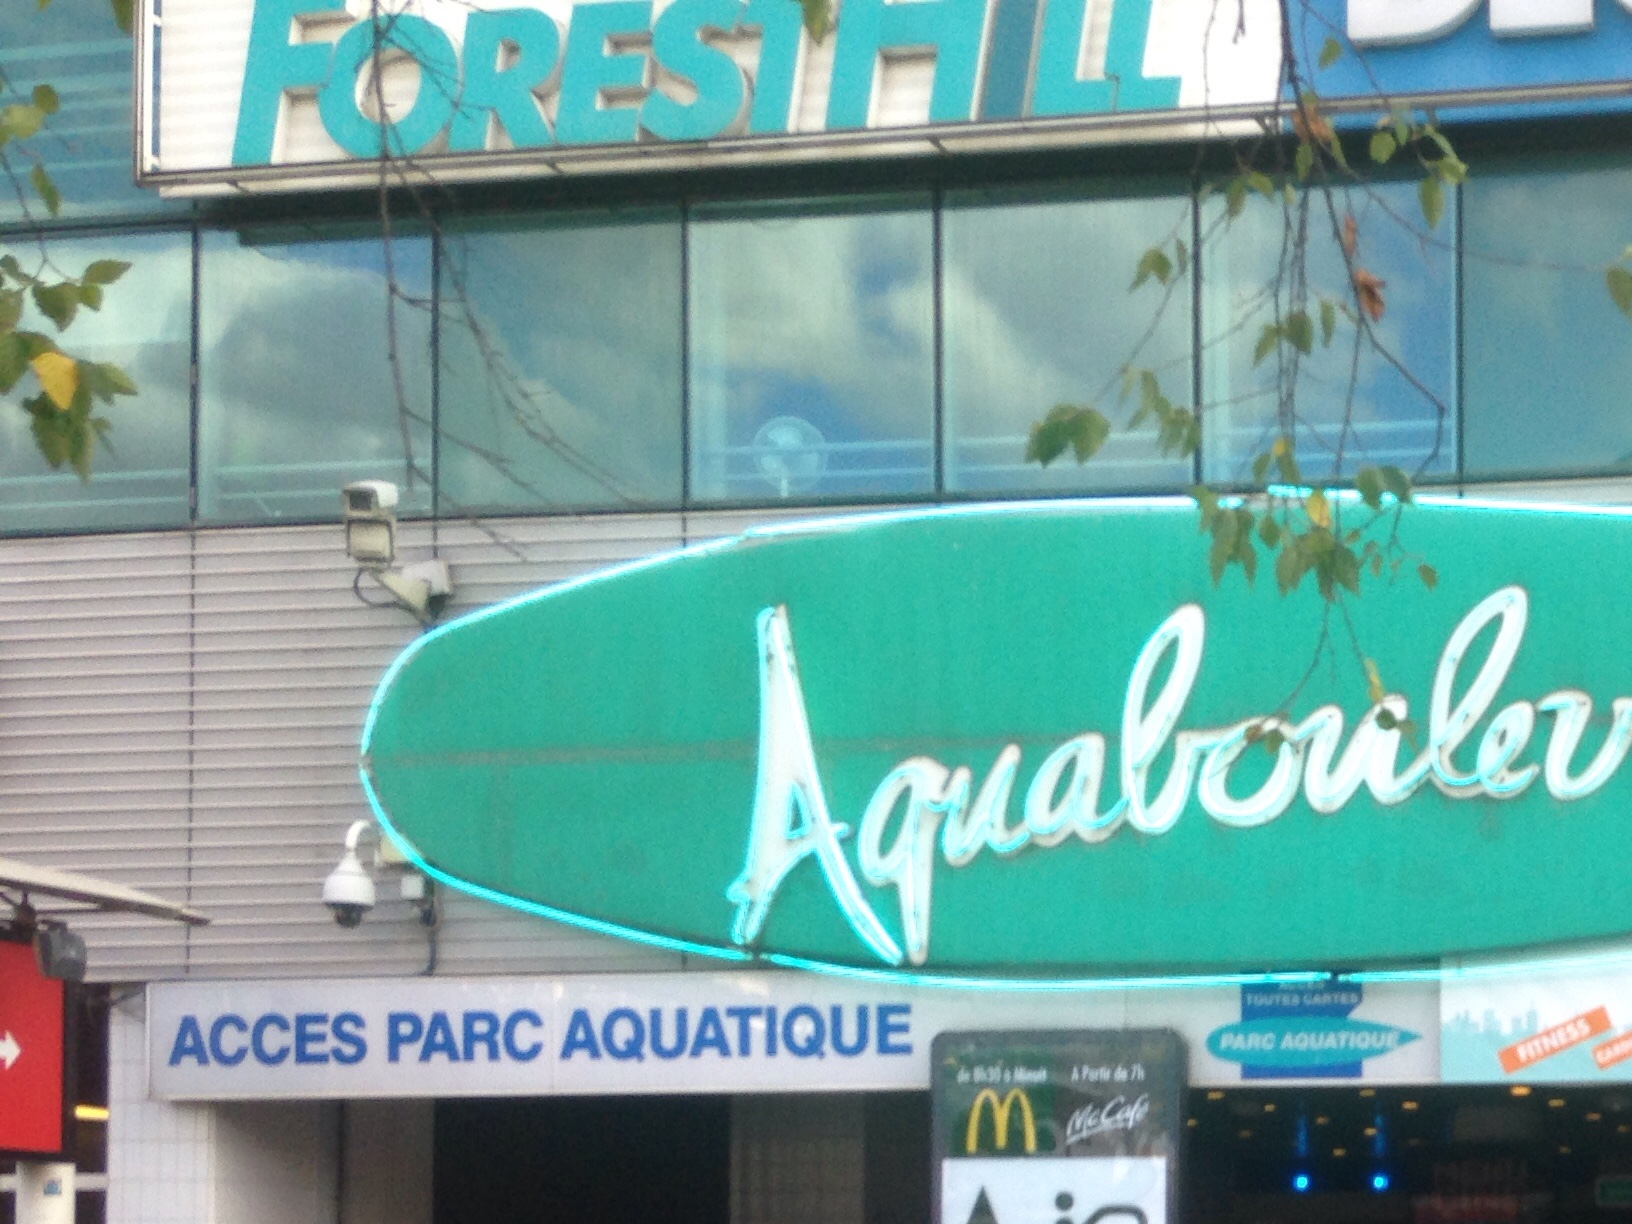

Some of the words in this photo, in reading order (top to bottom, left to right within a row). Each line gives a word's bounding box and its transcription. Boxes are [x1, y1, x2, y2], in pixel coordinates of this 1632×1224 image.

[168, 1012, 369, 1067] ACCES
[387, 1008, 545, 1064] PARC
[561, 1004, 914, 1062] AQUATIQUE
[1219, 1032, 1276, 1051] PARC
[1280, 1029, 1400, 1051] AQUATIQUE
[1516, 1016, 1592, 1063] FITNESS
